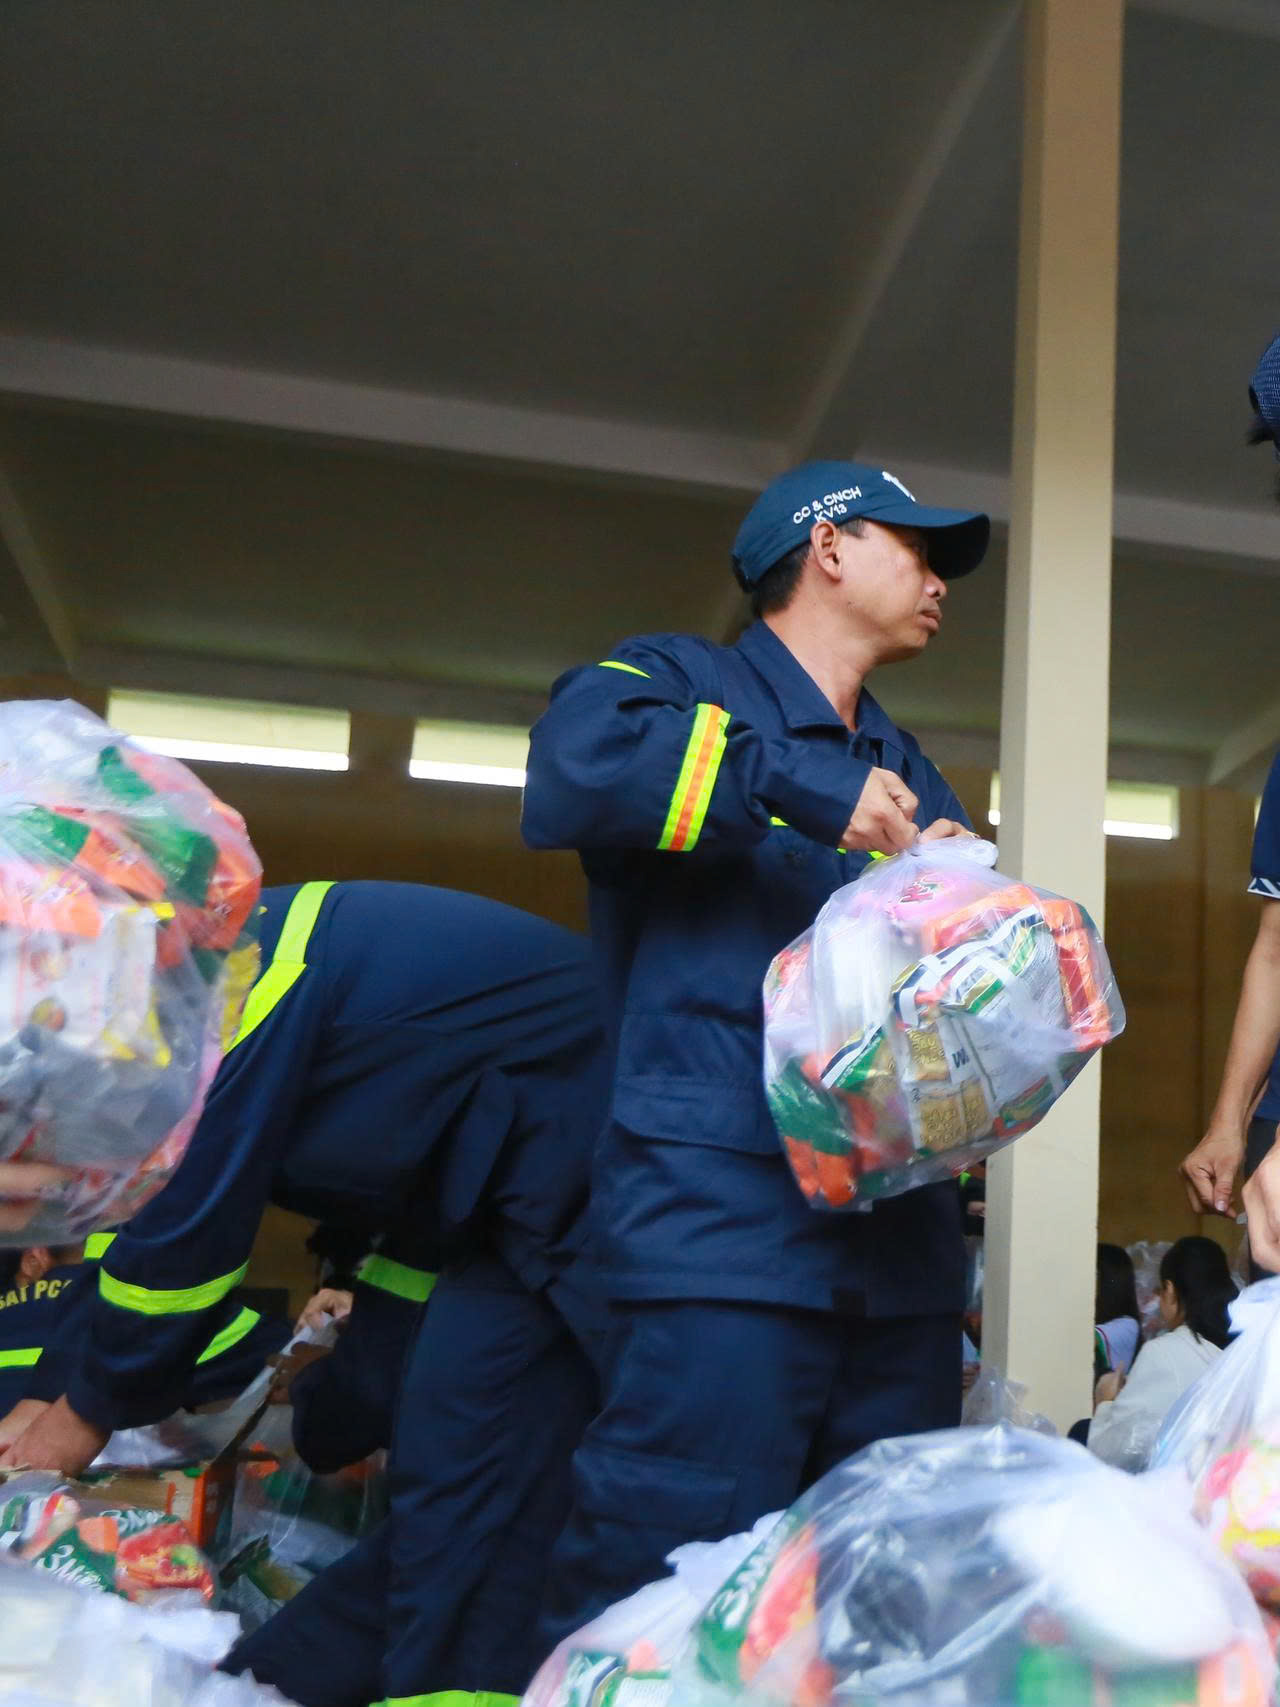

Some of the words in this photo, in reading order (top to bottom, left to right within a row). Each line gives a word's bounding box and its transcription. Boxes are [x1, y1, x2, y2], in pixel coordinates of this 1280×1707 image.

[812, 500, 823, 512] &
[823, 485, 862, 506] CNCH
[814, 503, 848, 523] KV13
[34, 1279, 73, 1300] PC
